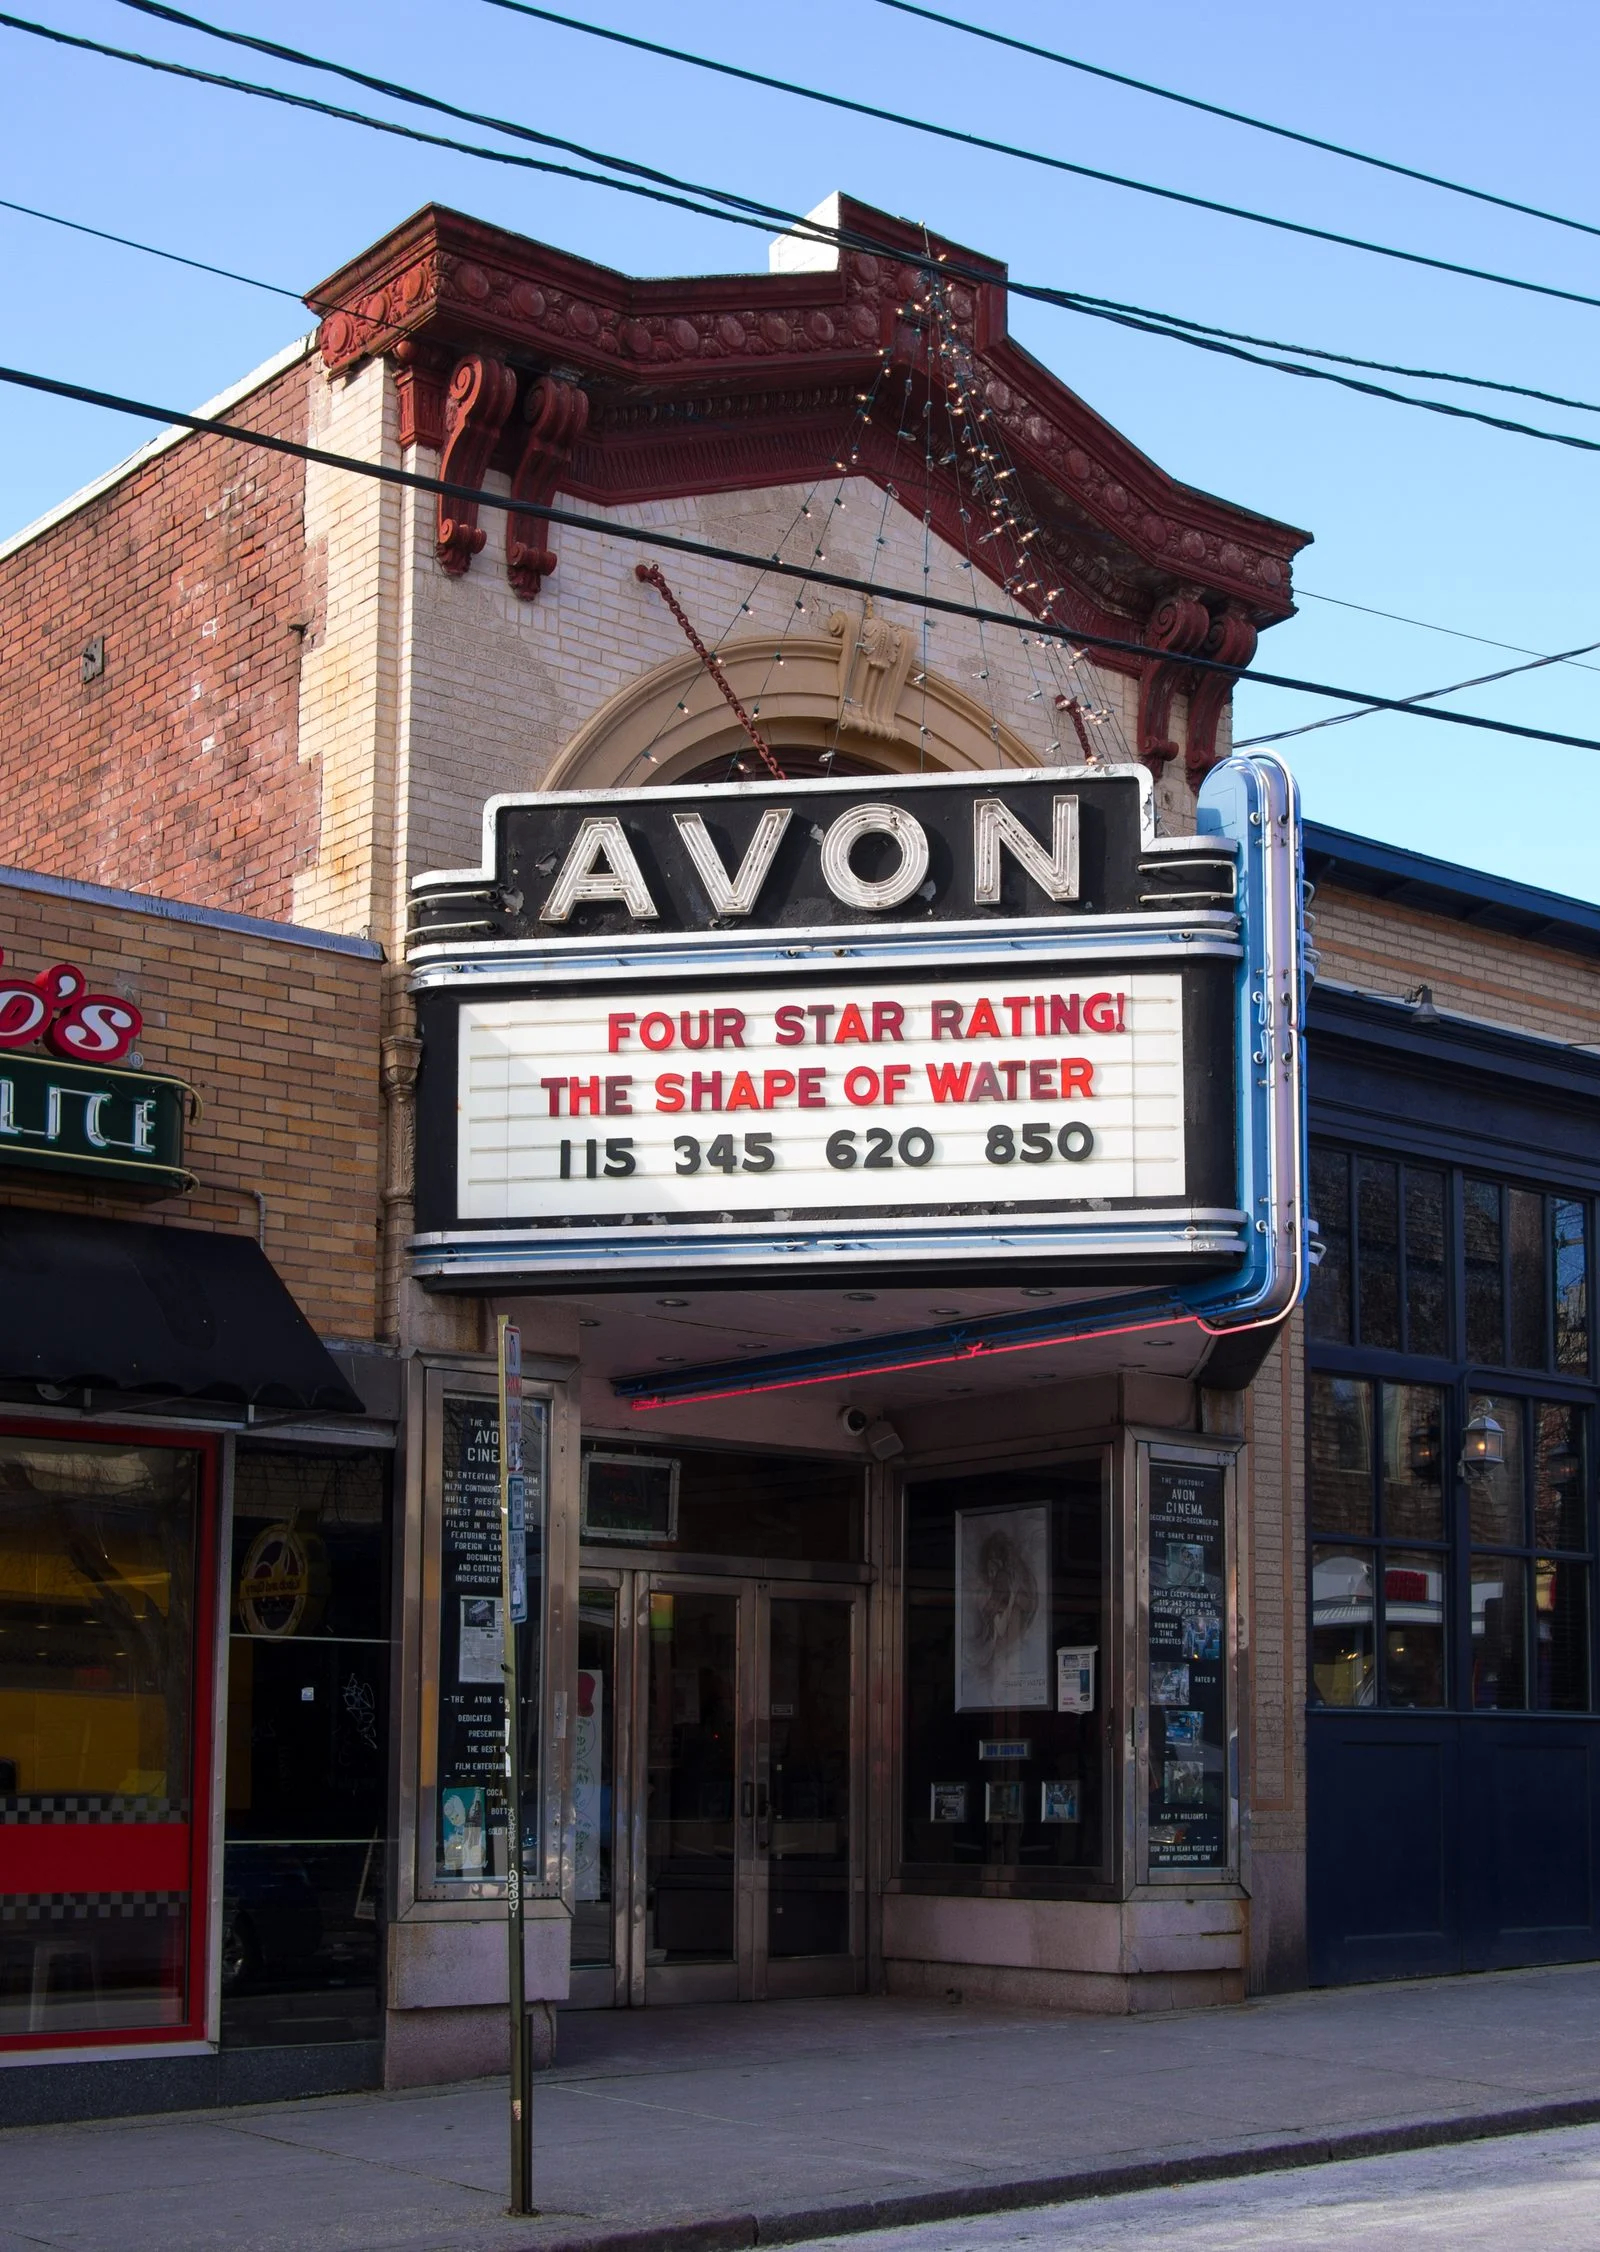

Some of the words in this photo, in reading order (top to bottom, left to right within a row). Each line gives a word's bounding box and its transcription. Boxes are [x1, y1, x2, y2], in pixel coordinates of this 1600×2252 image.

[539, 795, 1080, 925] AVON
[608, 1008, 747, 1053] FOUR
[776, 1000, 905, 1046] STAR
[930, 993, 1126, 1041] RATING!
[541, 1075, 632, 1117] THE
[656, 1067, 826, 1114] SHAPE
[844, 1063, 911, 1107] OF
[926, 1057, 1095, 1104] WATER
[559, 1138, 636, 1180] 115
[675, 1132, 775, 1176] 345
[826, 1126, 935, 1169] 620
[986, 1120, 1094, 1163] 850
[470, 1418, 483, 1427] THE
[474, 1430, 499, 1445] AVO
[467, 1447, 500, 1462] CINE
[445, 1470, 453, 1478] TO
[457, 1472, 496, 1481] ENTERTAIN
[1161, 1476, 1172, 1485] THE
[1178, 1478, 1205, 1487] HISTORIC
[1171, 1488, 1195, 1501] AVON
[445, 1496, 467, 1504] WHILE
[446, 1508, 471, 1517] FINEST
[1166, 1501, 1203, 1516] CINEMA
[445, 1519, 469, 1528] FILMS
[474, 1521, 480, 1529] IN
[451, 1531, 486, 1540] FEATURING
[1155, 1530, 1165, 1538] THE
[1167, 1531, 1185, 1540] SHAPE
[1196, 1534, 1214, 1542] WATER
[454, 1542, 482, 1551] FOREIGN
[458, 1564, 471, 1572] AND
[455, 1574, 500, 1584] INDEPENDENT
[1154, 1622, 1178, 1630] RUNNING
[1159, 1630, 1174, 1638] TIME
[474, 1695, 492, 1704] AVON
[457, 1714, 492, 1723] DEDICATED
[466, 1745, 479, 1753] THE
[481, 1745, 496, 1753] BEST
[455, 1762, 471, 1770] FILM
[486, 1788, 503, 1796] COCA
